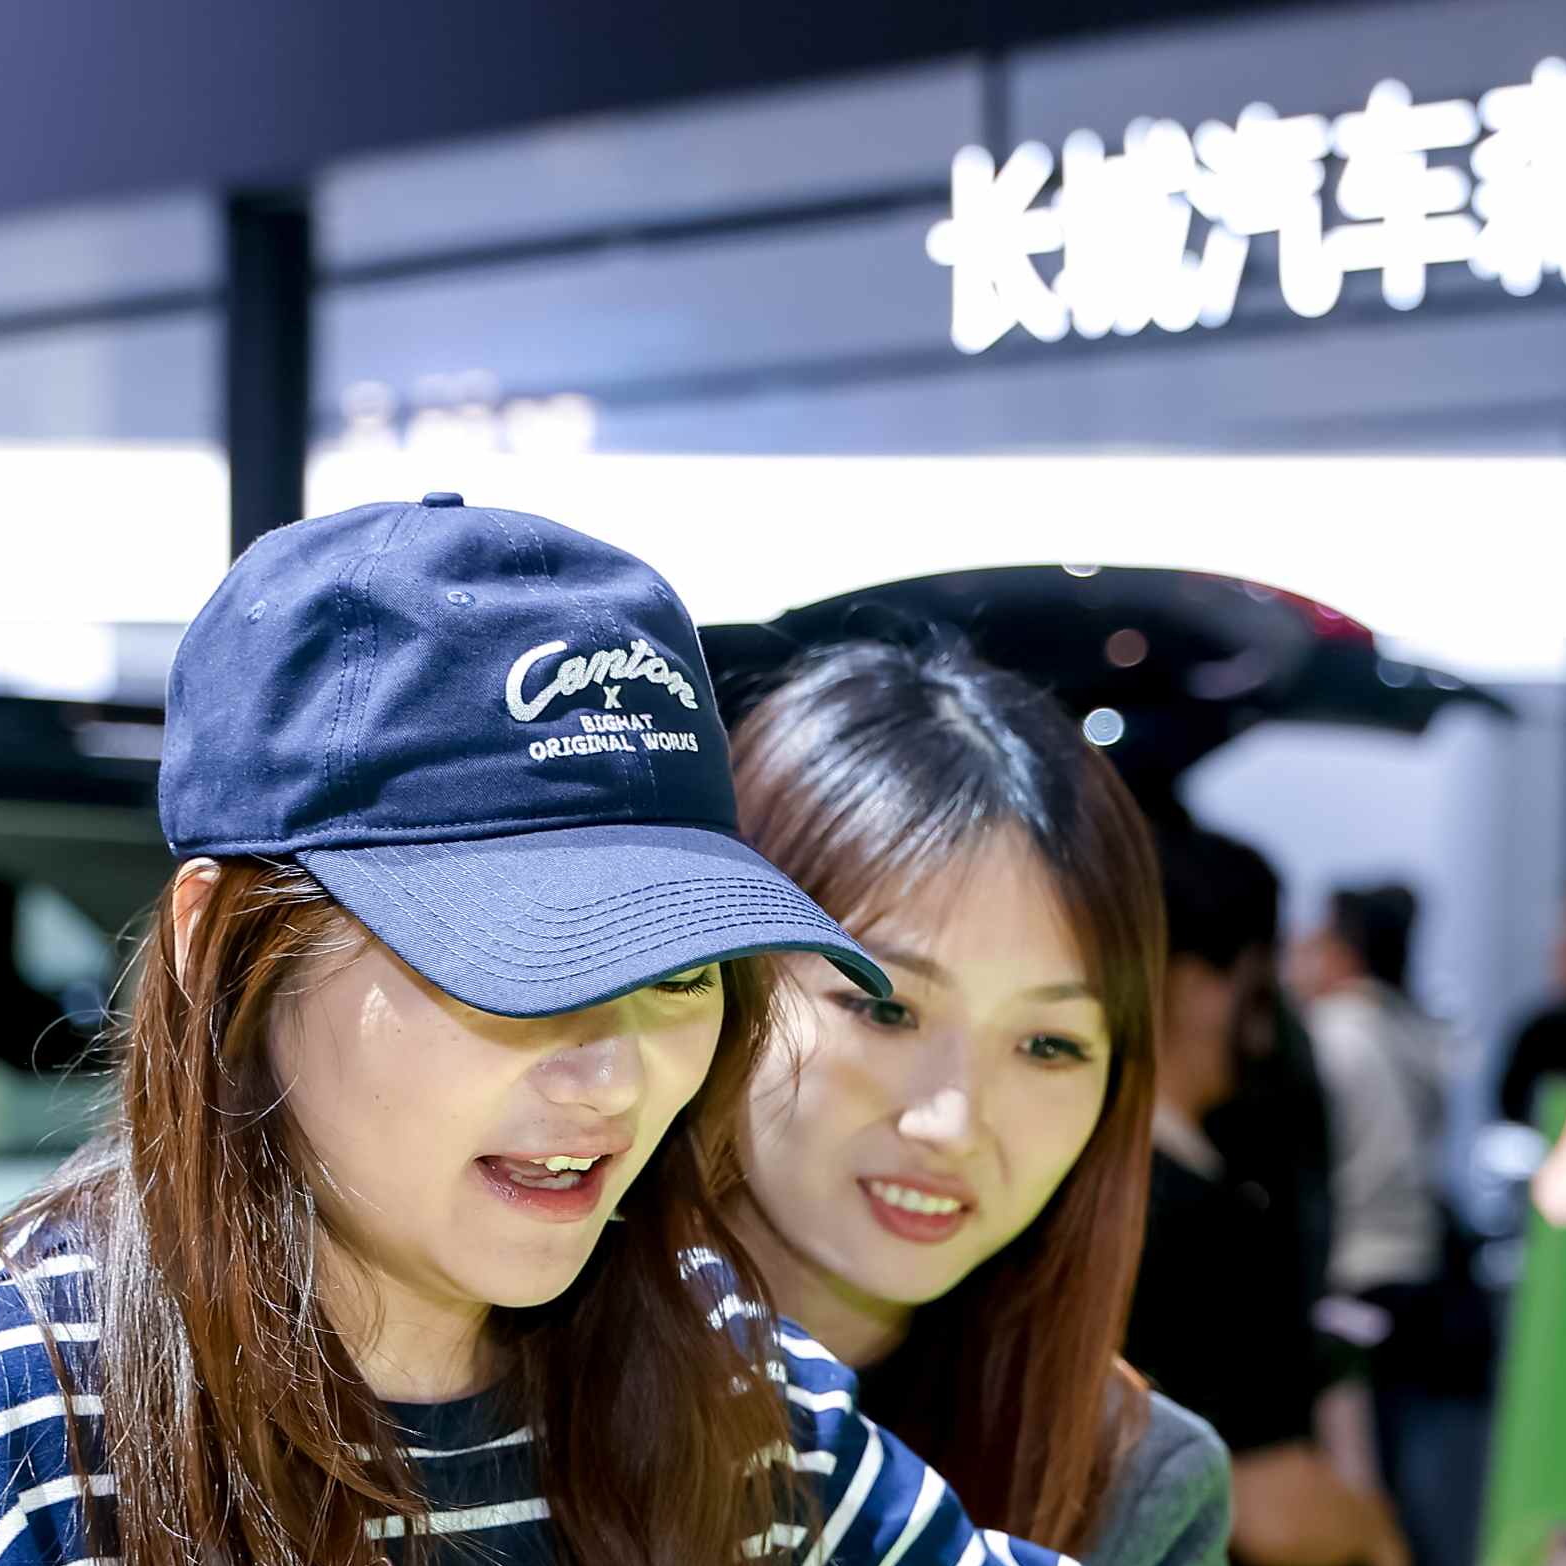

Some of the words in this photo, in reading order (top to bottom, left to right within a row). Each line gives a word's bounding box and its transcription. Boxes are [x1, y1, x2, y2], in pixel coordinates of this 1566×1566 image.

[579, 713, 654, 734] BIGHAT
[529, 734, 637, 762] ORIGINAL
[640, 731, 699, 753] WORKS
